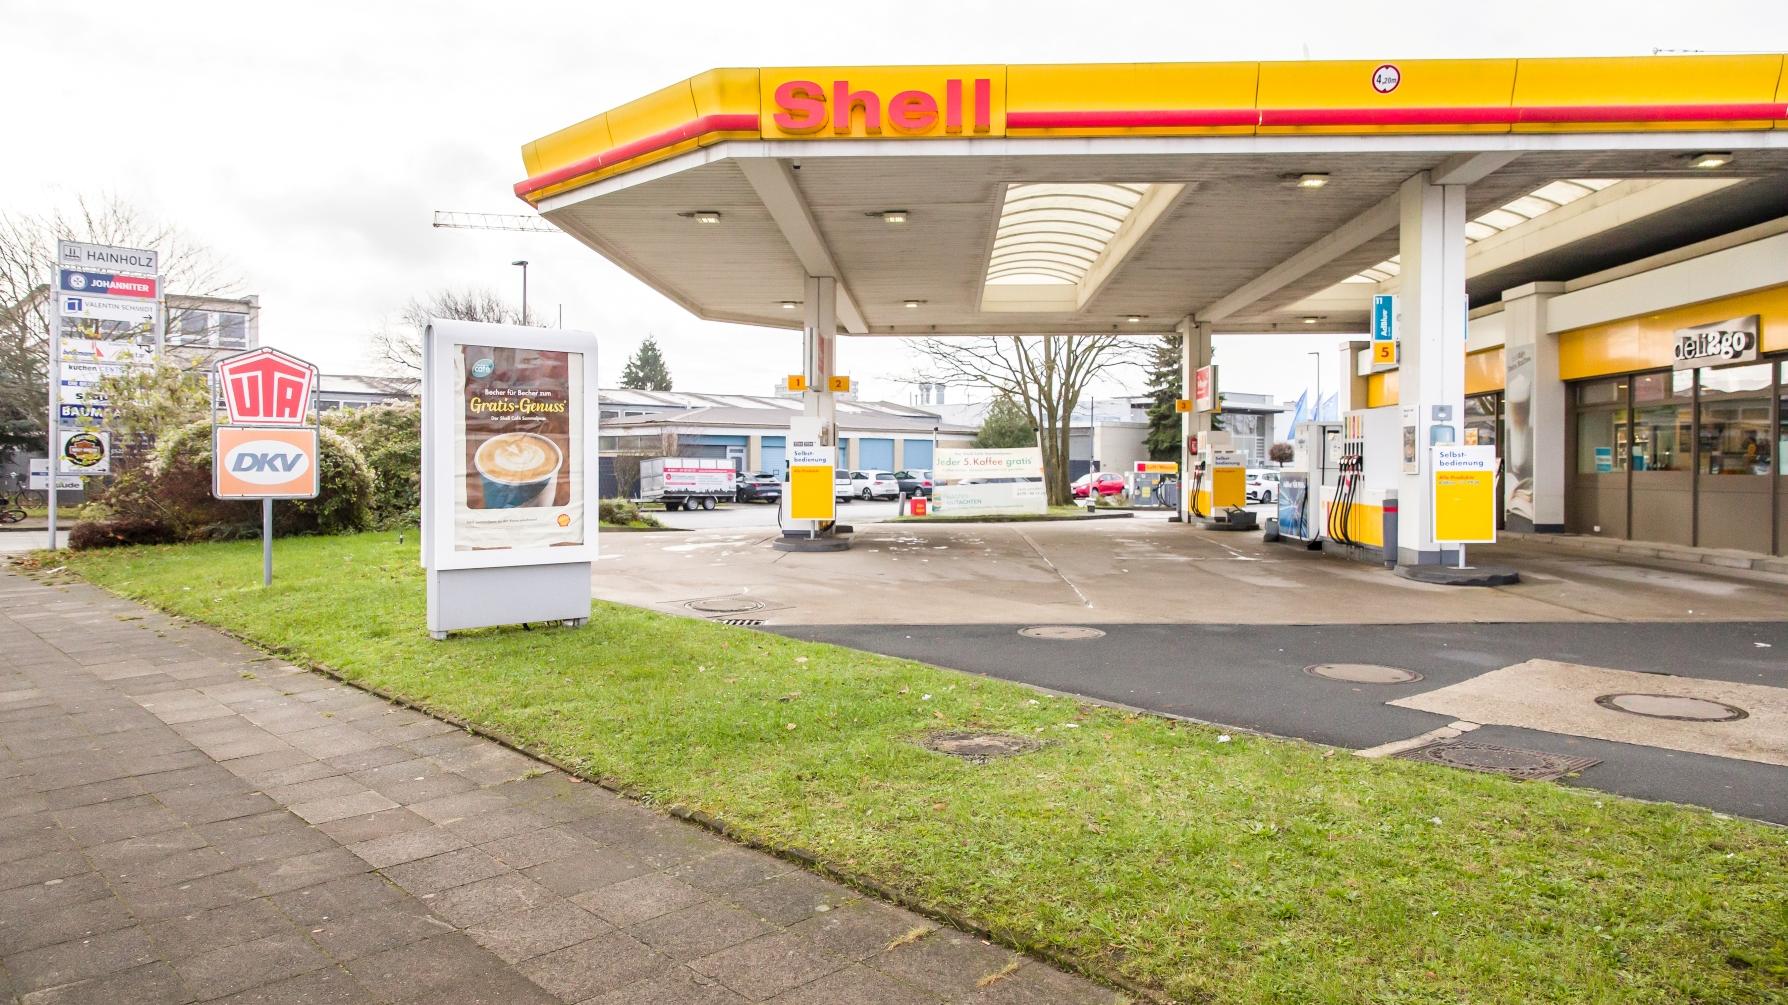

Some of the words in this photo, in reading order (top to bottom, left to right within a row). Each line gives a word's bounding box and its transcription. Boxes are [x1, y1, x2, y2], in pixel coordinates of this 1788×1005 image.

[773, 79, 991, 134] Shell
[87, 250, 153, 268] HAINHOLZ
[90, 279, 150, 293] JOHANNITER
[85, 302, 120, 310] VALENTIN
[1380, 309, 1388, 337] AdBlue
[1380, 347, 1389, 358] 5
[1674, 332, 1746, 360] deli2go
[228, 357, 306, 418] UTA
[796, 378, 800, 387] 1
[834, 379, 842, 388] 2
[484, 388, 506, 396] Becher
[517, 389, 539, 397] Becher
[231, 452, 304, 473] DKV
[936, 458, 961, 467] Jeder
